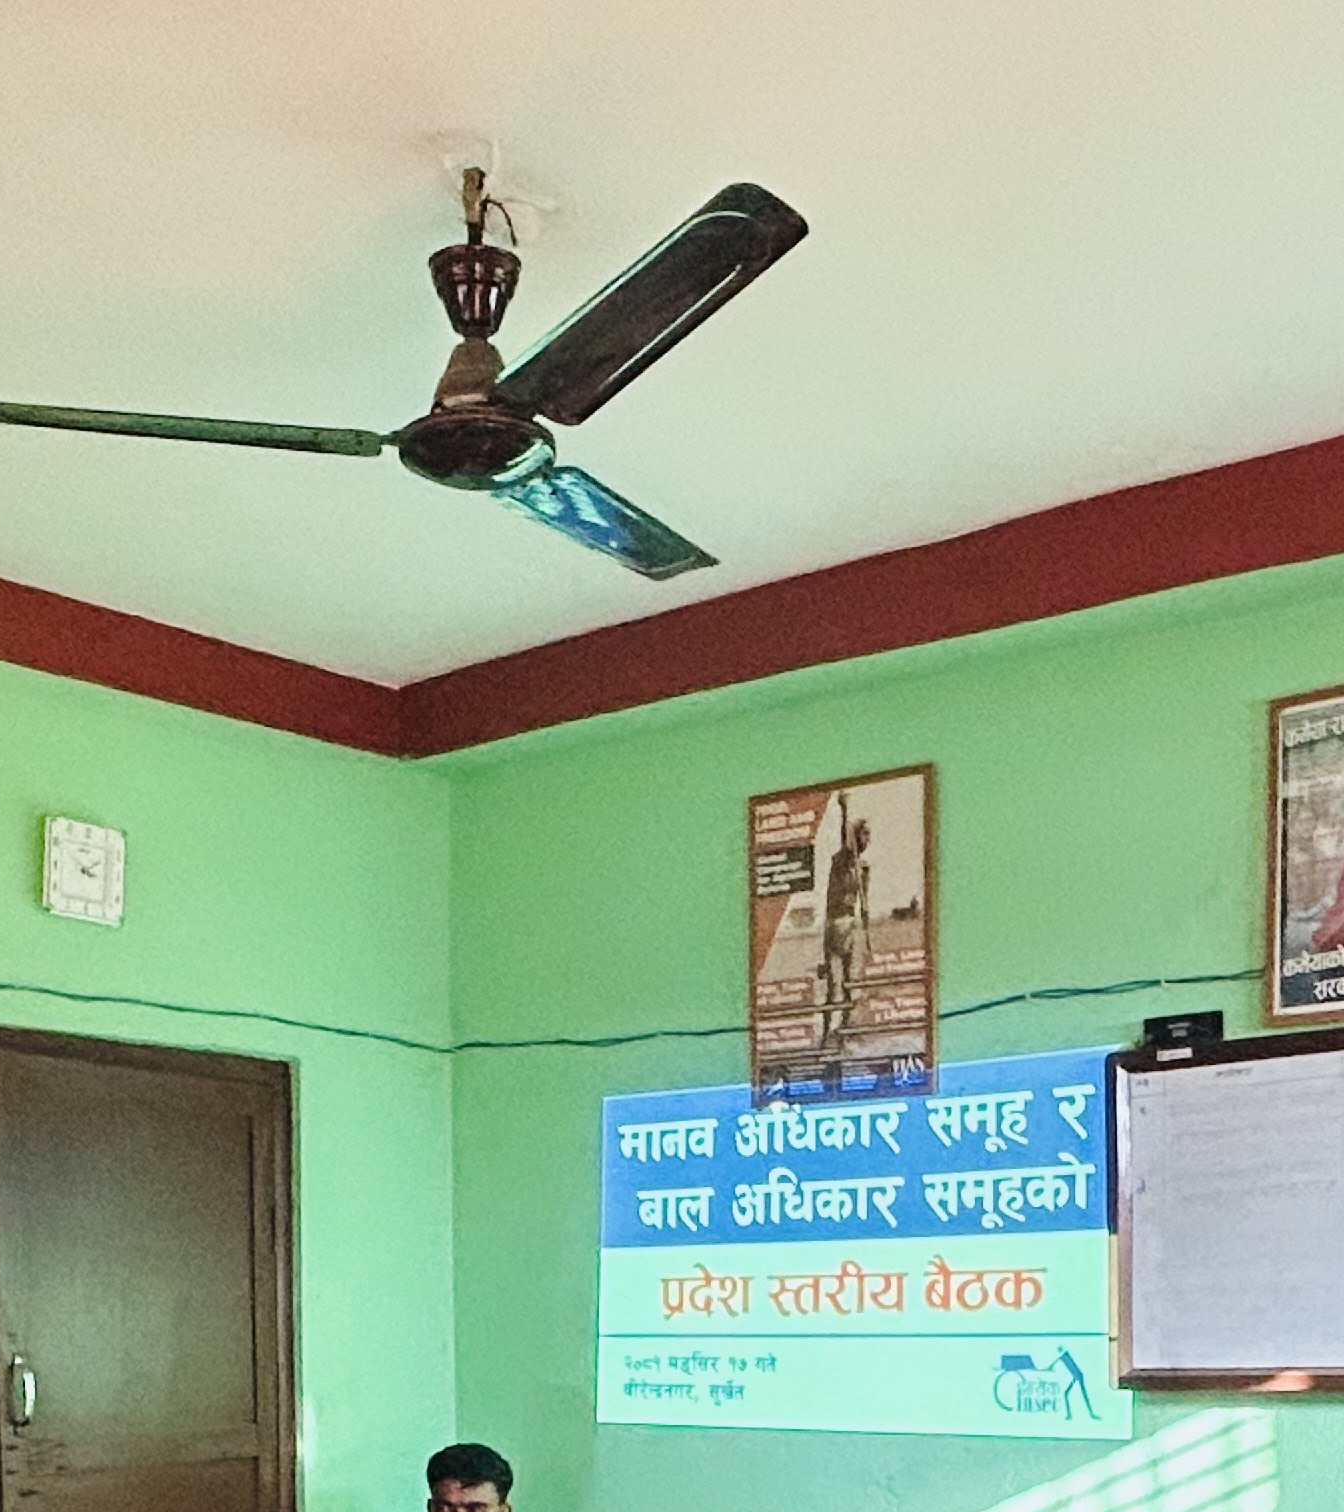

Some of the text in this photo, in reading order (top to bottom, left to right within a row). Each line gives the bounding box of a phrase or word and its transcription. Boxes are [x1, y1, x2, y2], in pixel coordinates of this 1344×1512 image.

[618, 1084, 1096, 1163] मानव अधिकार समूह र
[637, 1152, 1096, 1231] बाल अधिकार समूहको
[660, 1254, 1048, 1321] प्रदेश स्तरीय बैठक
[755, 1352, 777, 1373] गते
